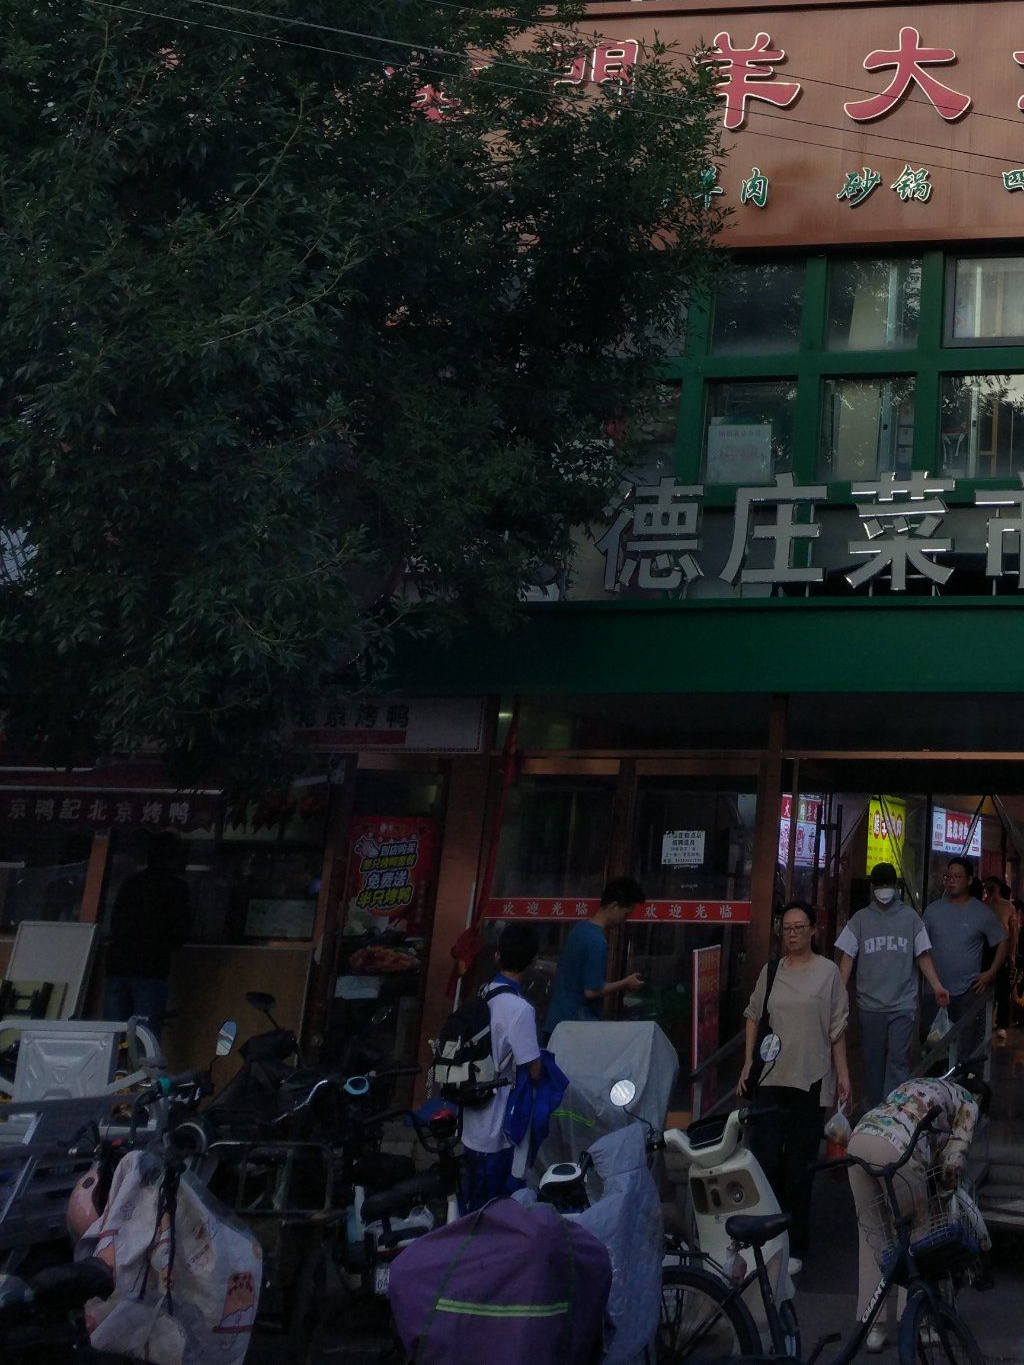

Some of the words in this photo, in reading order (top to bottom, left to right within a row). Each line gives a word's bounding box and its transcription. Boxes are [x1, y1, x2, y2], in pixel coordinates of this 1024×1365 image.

[503, 901, 588, 916] 欢迎光临
[644, 902, 733, 919] 欢迎光临
